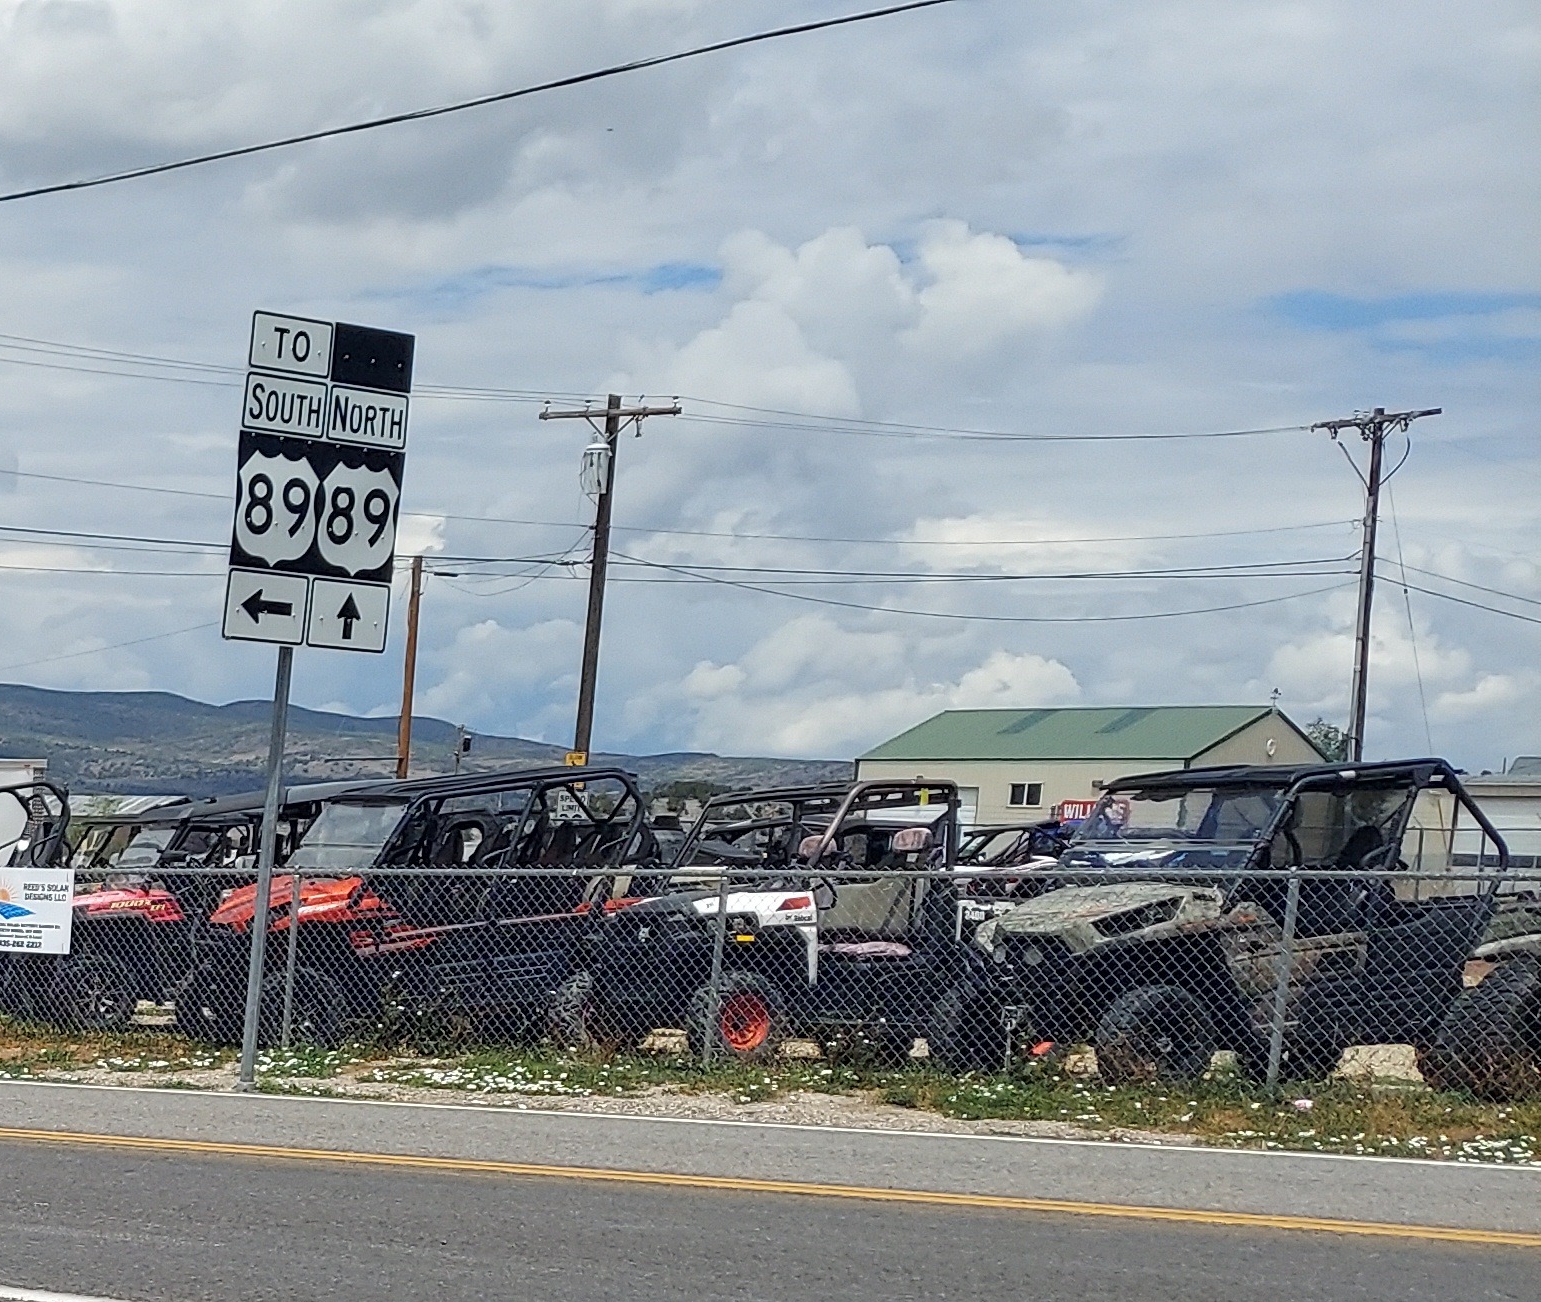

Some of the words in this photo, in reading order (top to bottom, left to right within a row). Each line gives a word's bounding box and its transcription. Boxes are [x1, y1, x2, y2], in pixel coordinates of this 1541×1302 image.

[273, 326, 311, 362] TO
[248, 382, 322, 429] SOUTH
[331, 394, 404, 440] NORTH
[244, 472, 311, 538] 89
[326, 486, 391, 548] 89
